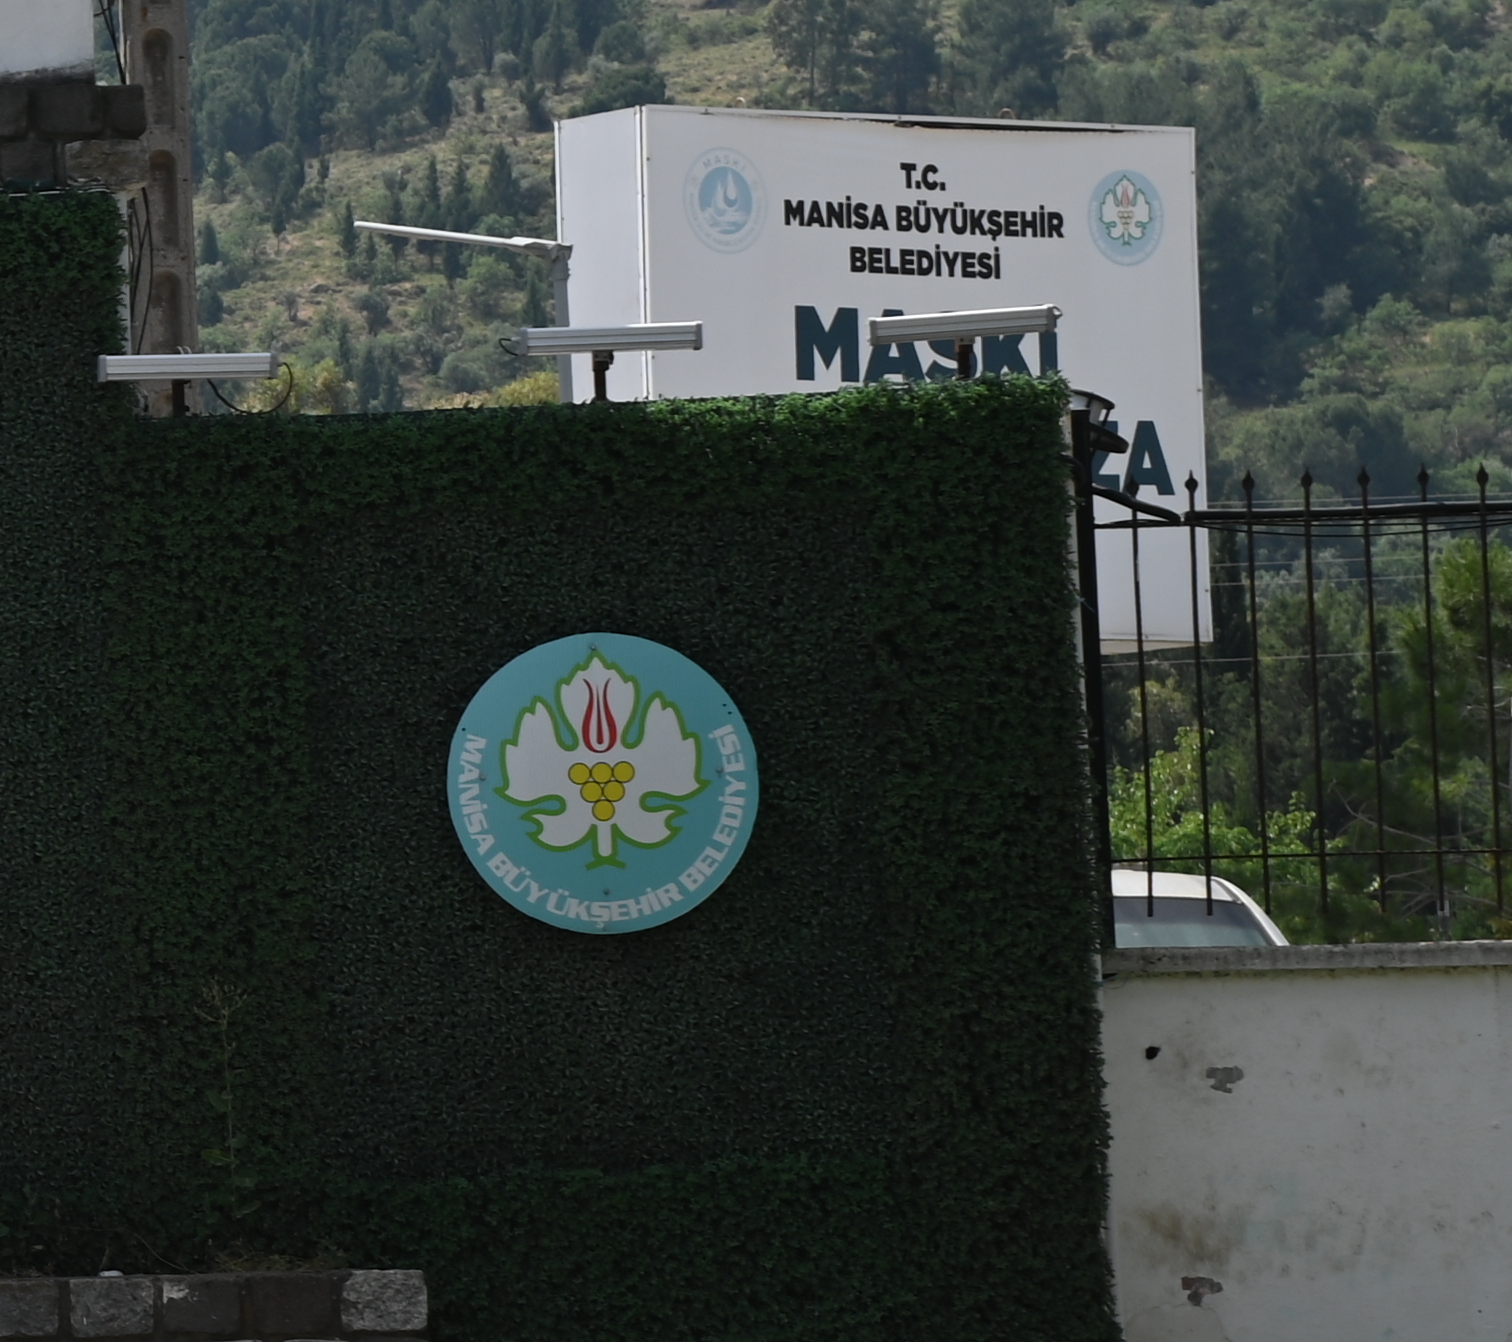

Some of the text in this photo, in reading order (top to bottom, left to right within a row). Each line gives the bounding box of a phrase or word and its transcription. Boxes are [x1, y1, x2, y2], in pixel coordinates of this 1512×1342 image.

[900, 162, 946, 191] T.C.
[783, 195, 889, 231] MANİSA
[895, 199, 1064, 241] BÜYÜKŞEHİR
[849, 244, 1001, 279] BELEDİYESİ
[458, 723, 747, 928] MANİSA BÜYÜKŞEHİR BELEDİYESİ
